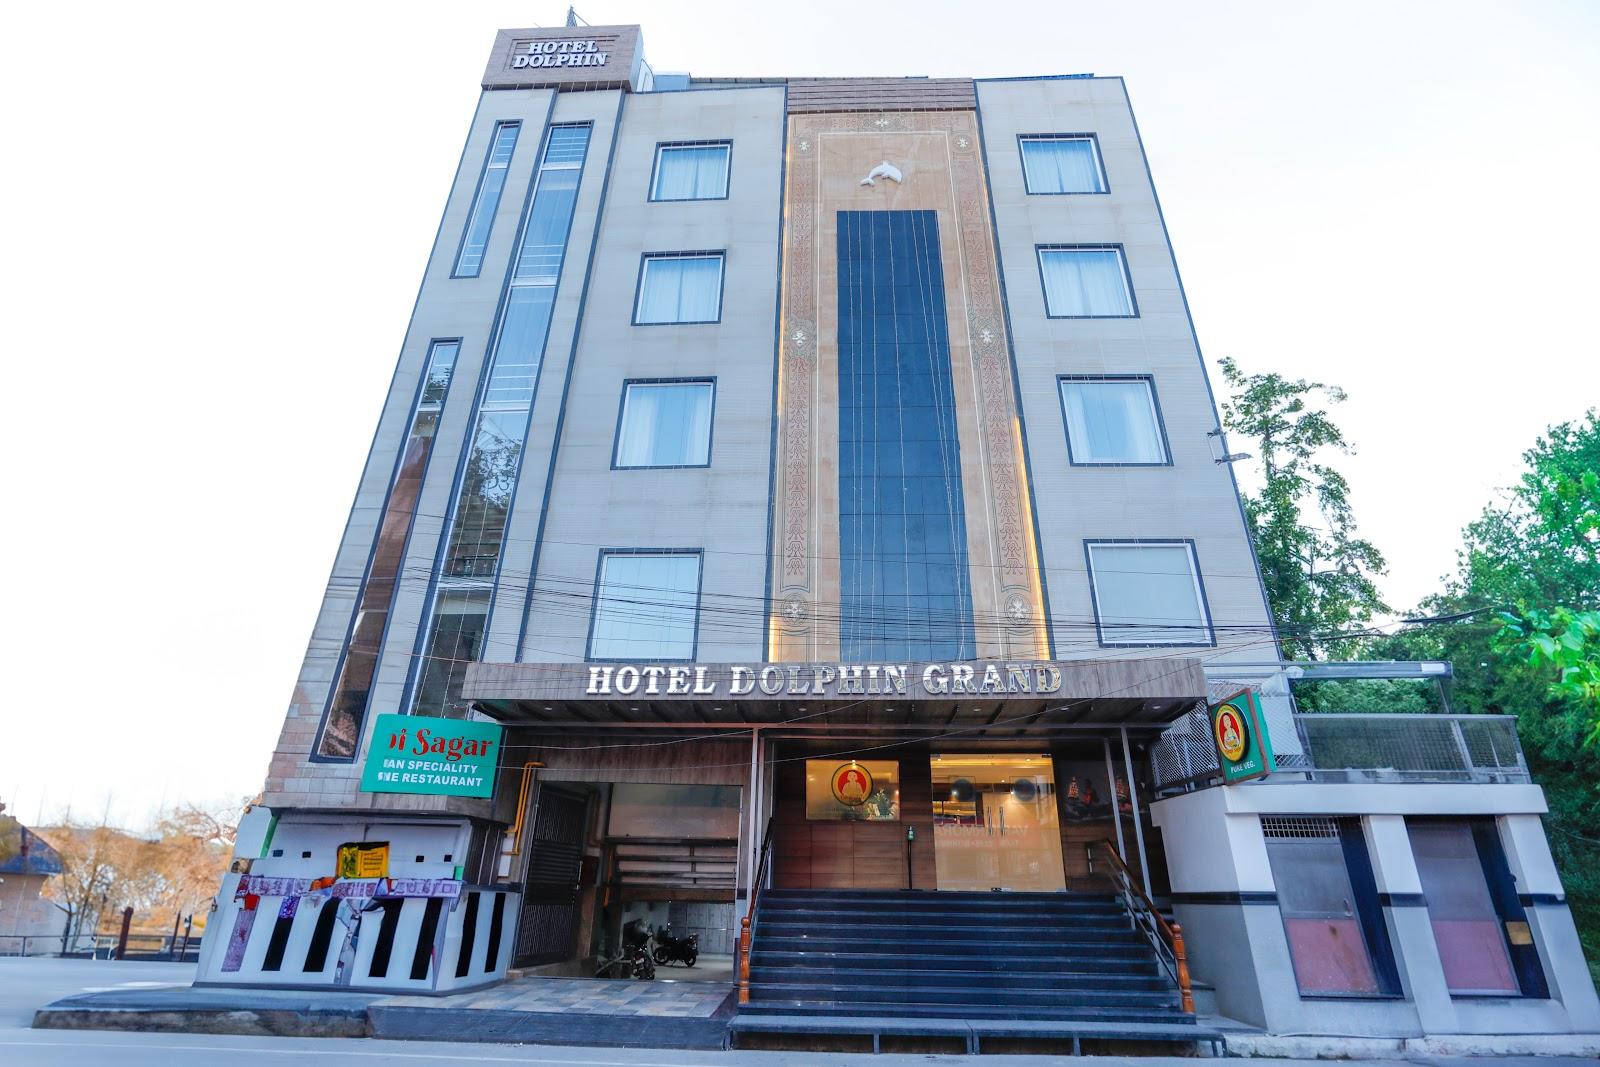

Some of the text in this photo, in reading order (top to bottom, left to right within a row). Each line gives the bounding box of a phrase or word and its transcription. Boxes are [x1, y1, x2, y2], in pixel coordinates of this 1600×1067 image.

[528, 41, 598, 55] HOTEL
[513, 53, 608, 69] DOLPHIN
[586, 664, 1062, 695] HOTEL DOLPHIN GRAND
[412, 728, 493, 762] Sagar
[408, 761, 478, 773] SPECIALITY
[402, 774, 482, 786] RESTAURANT
